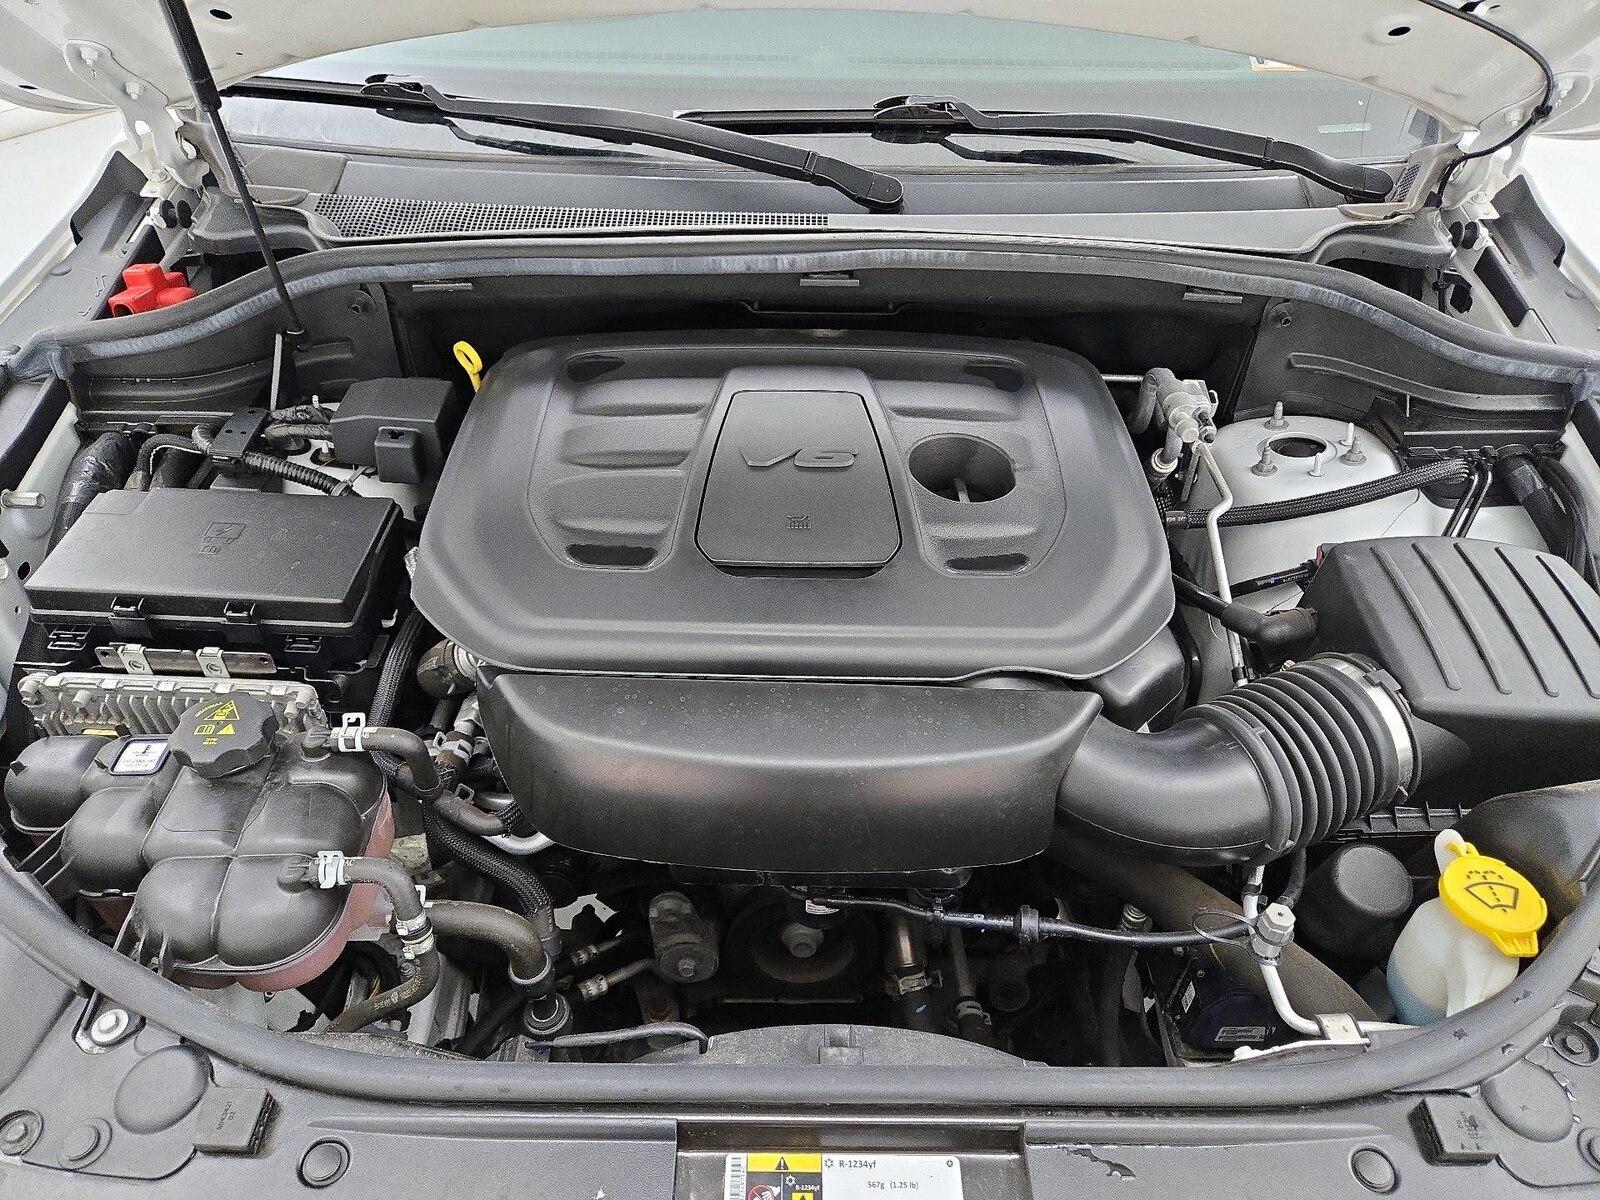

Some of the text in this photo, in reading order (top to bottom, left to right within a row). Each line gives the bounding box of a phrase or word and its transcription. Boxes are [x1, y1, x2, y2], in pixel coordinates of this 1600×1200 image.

[738, 448, 859, 469] V6
[839, 1160, 877, 1170] R-1234yf
[795, 1184, 820, 1192] R-1234yf
[867, 1181, 919, 1190] 567g (1.25 lb)
